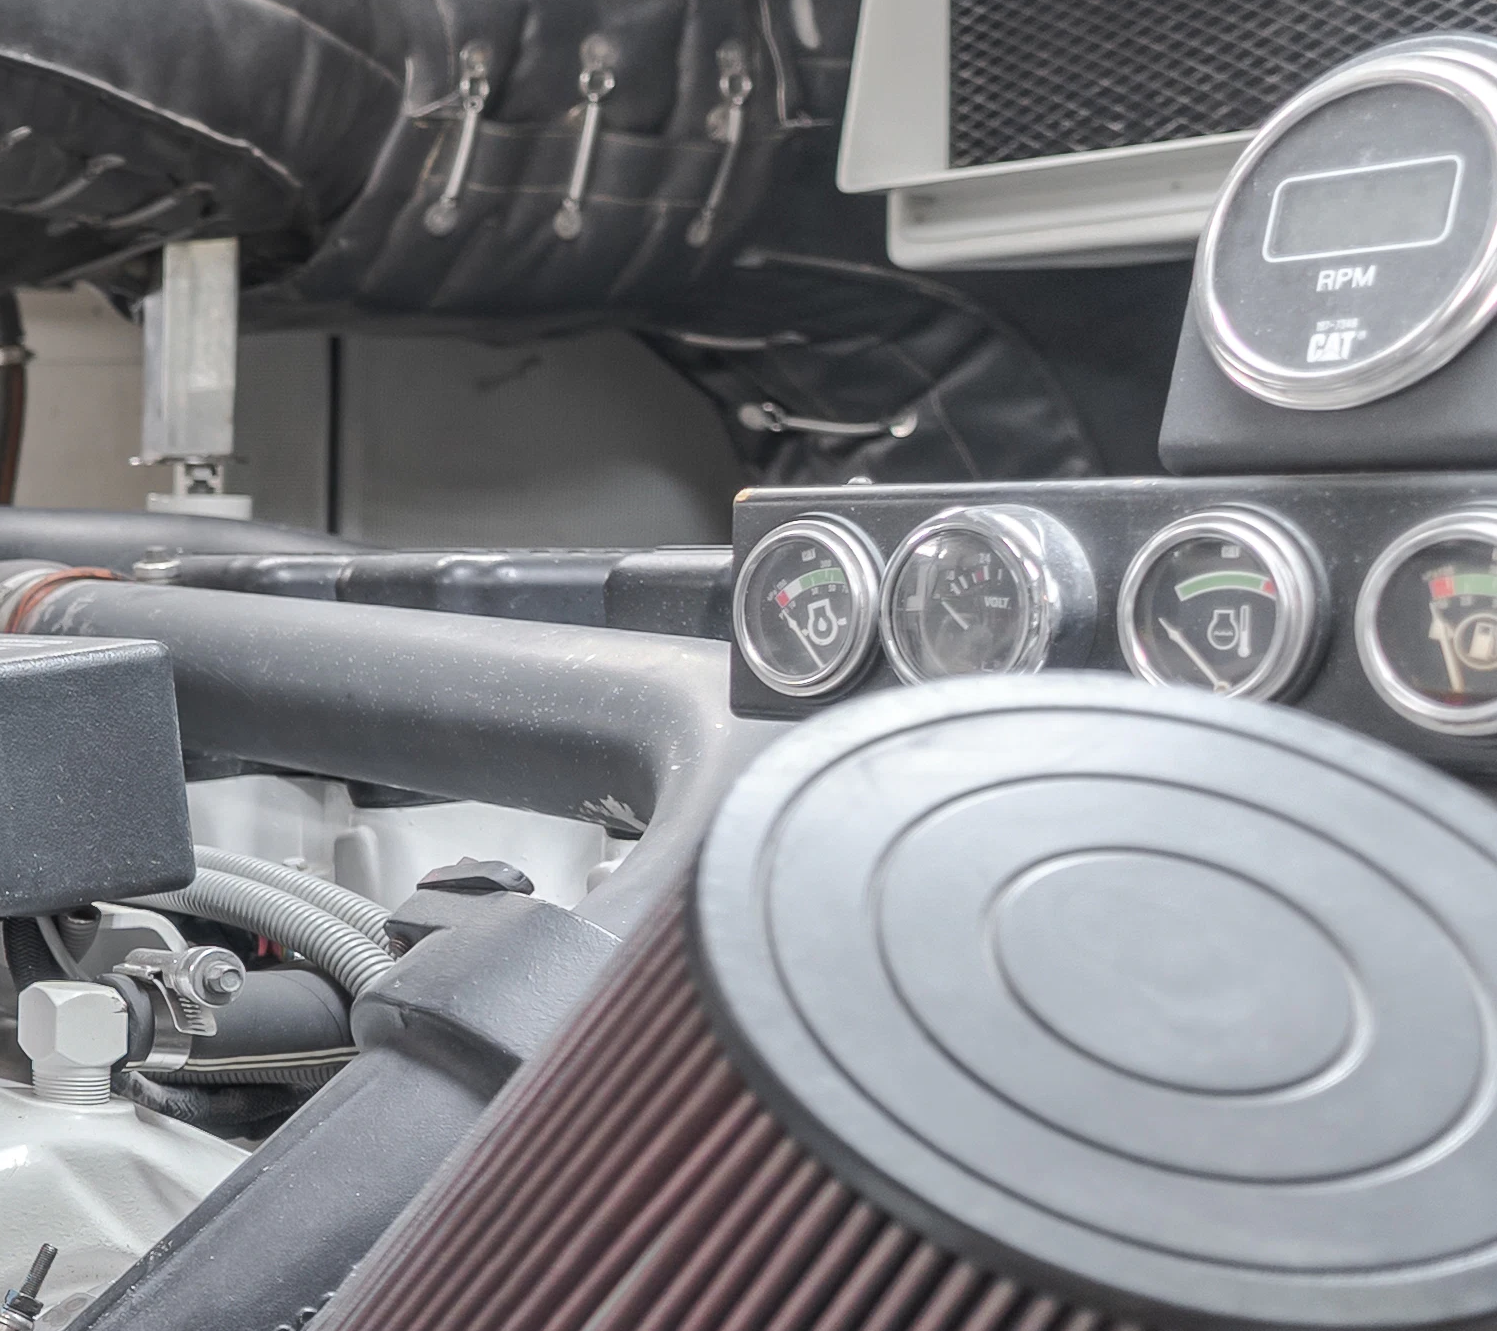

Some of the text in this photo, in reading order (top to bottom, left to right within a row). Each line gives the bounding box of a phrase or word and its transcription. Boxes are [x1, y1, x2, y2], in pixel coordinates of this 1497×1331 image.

[1316, 264, 1376, 292] RPM
[1306, 330, 1356, 363] CAT
[983, 595, 1010, 609] VOLT
